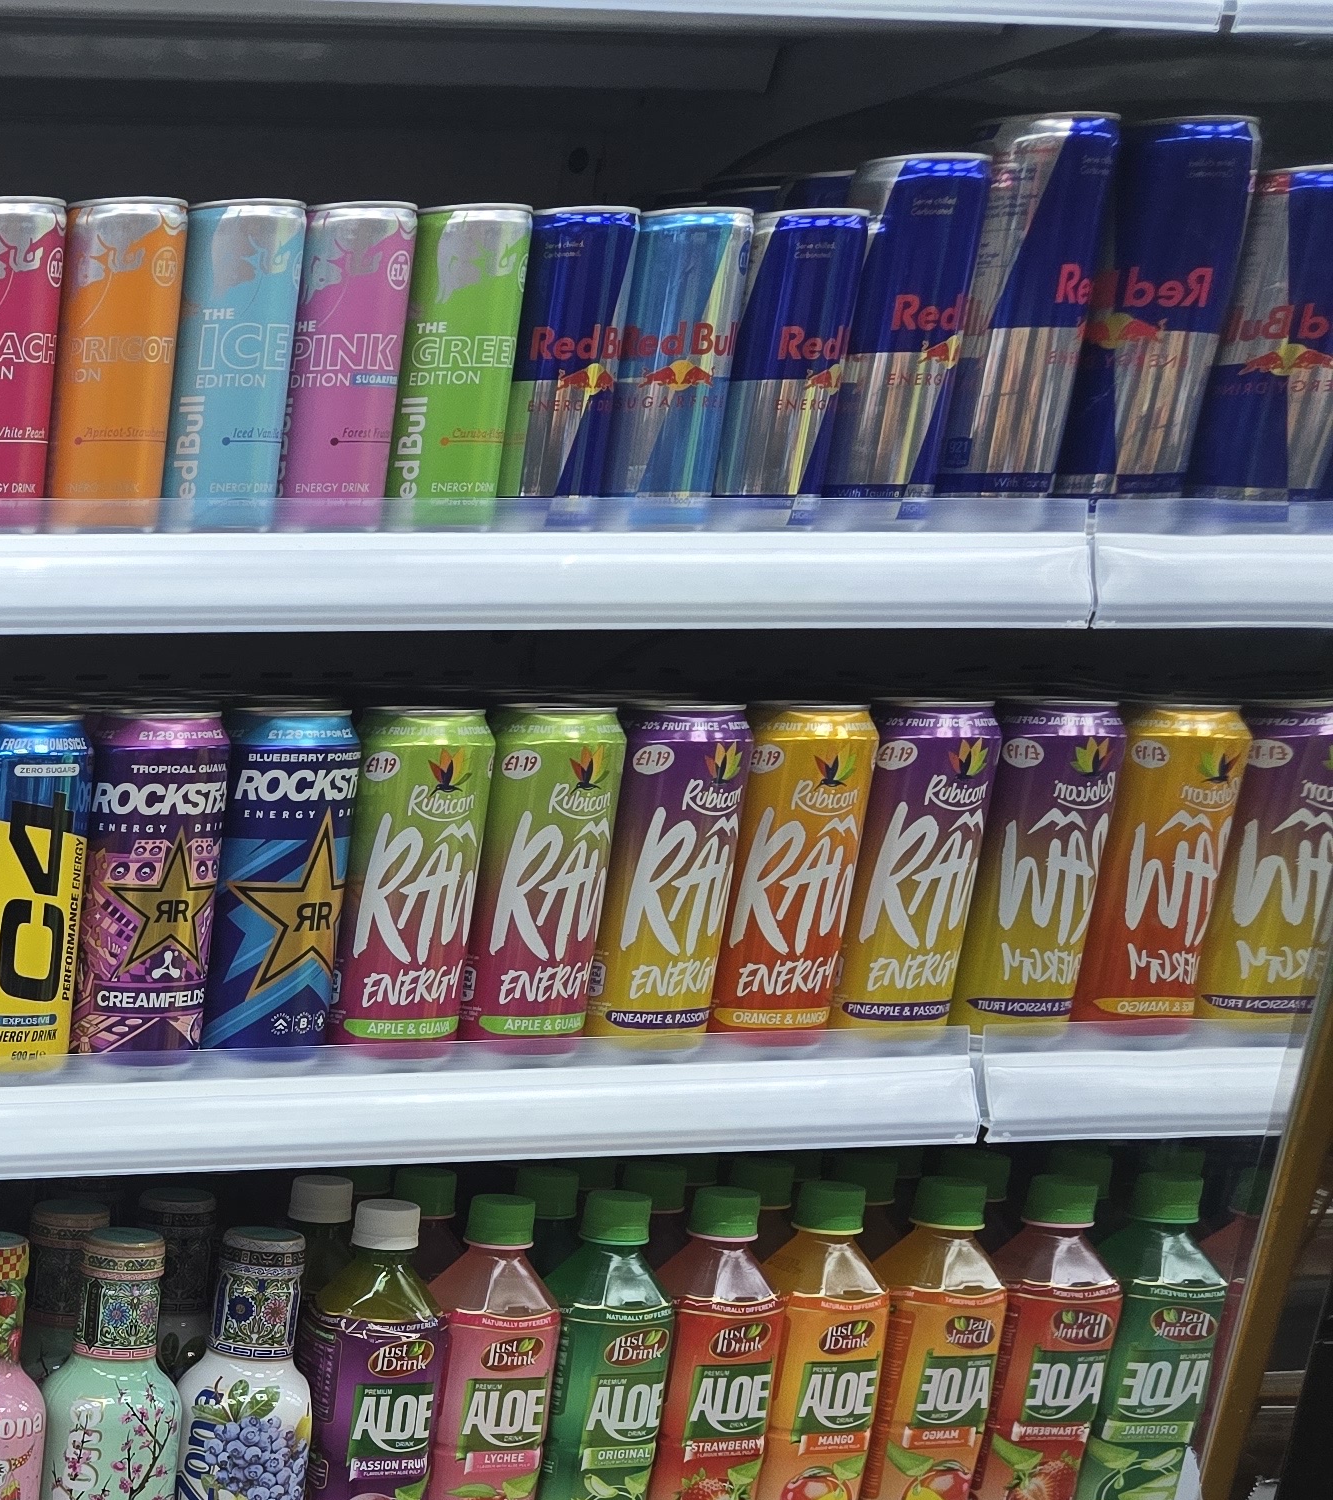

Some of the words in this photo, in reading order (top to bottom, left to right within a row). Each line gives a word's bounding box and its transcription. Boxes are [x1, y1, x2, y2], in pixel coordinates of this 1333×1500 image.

[248, 753, 323, 762] BLUEBERRY
[131, 765, 190, 774] TROPICAL
[193, 764, 226, 774] GUAVA
[408, 786, 474, 818] Rubicon
[97, 989, 206, 1008] CREAMFIELDS
[733, 1012, 779, 1024] ORANGE
[783, 1013, 793, 1024] &
[796, 1012, 828, 1024] MANGO
[353, 1394, 433, 1440] ALOE
[818, 1435, 854, 1446] MANGO
[484, 1452, 524, 1464] LYCHEE
